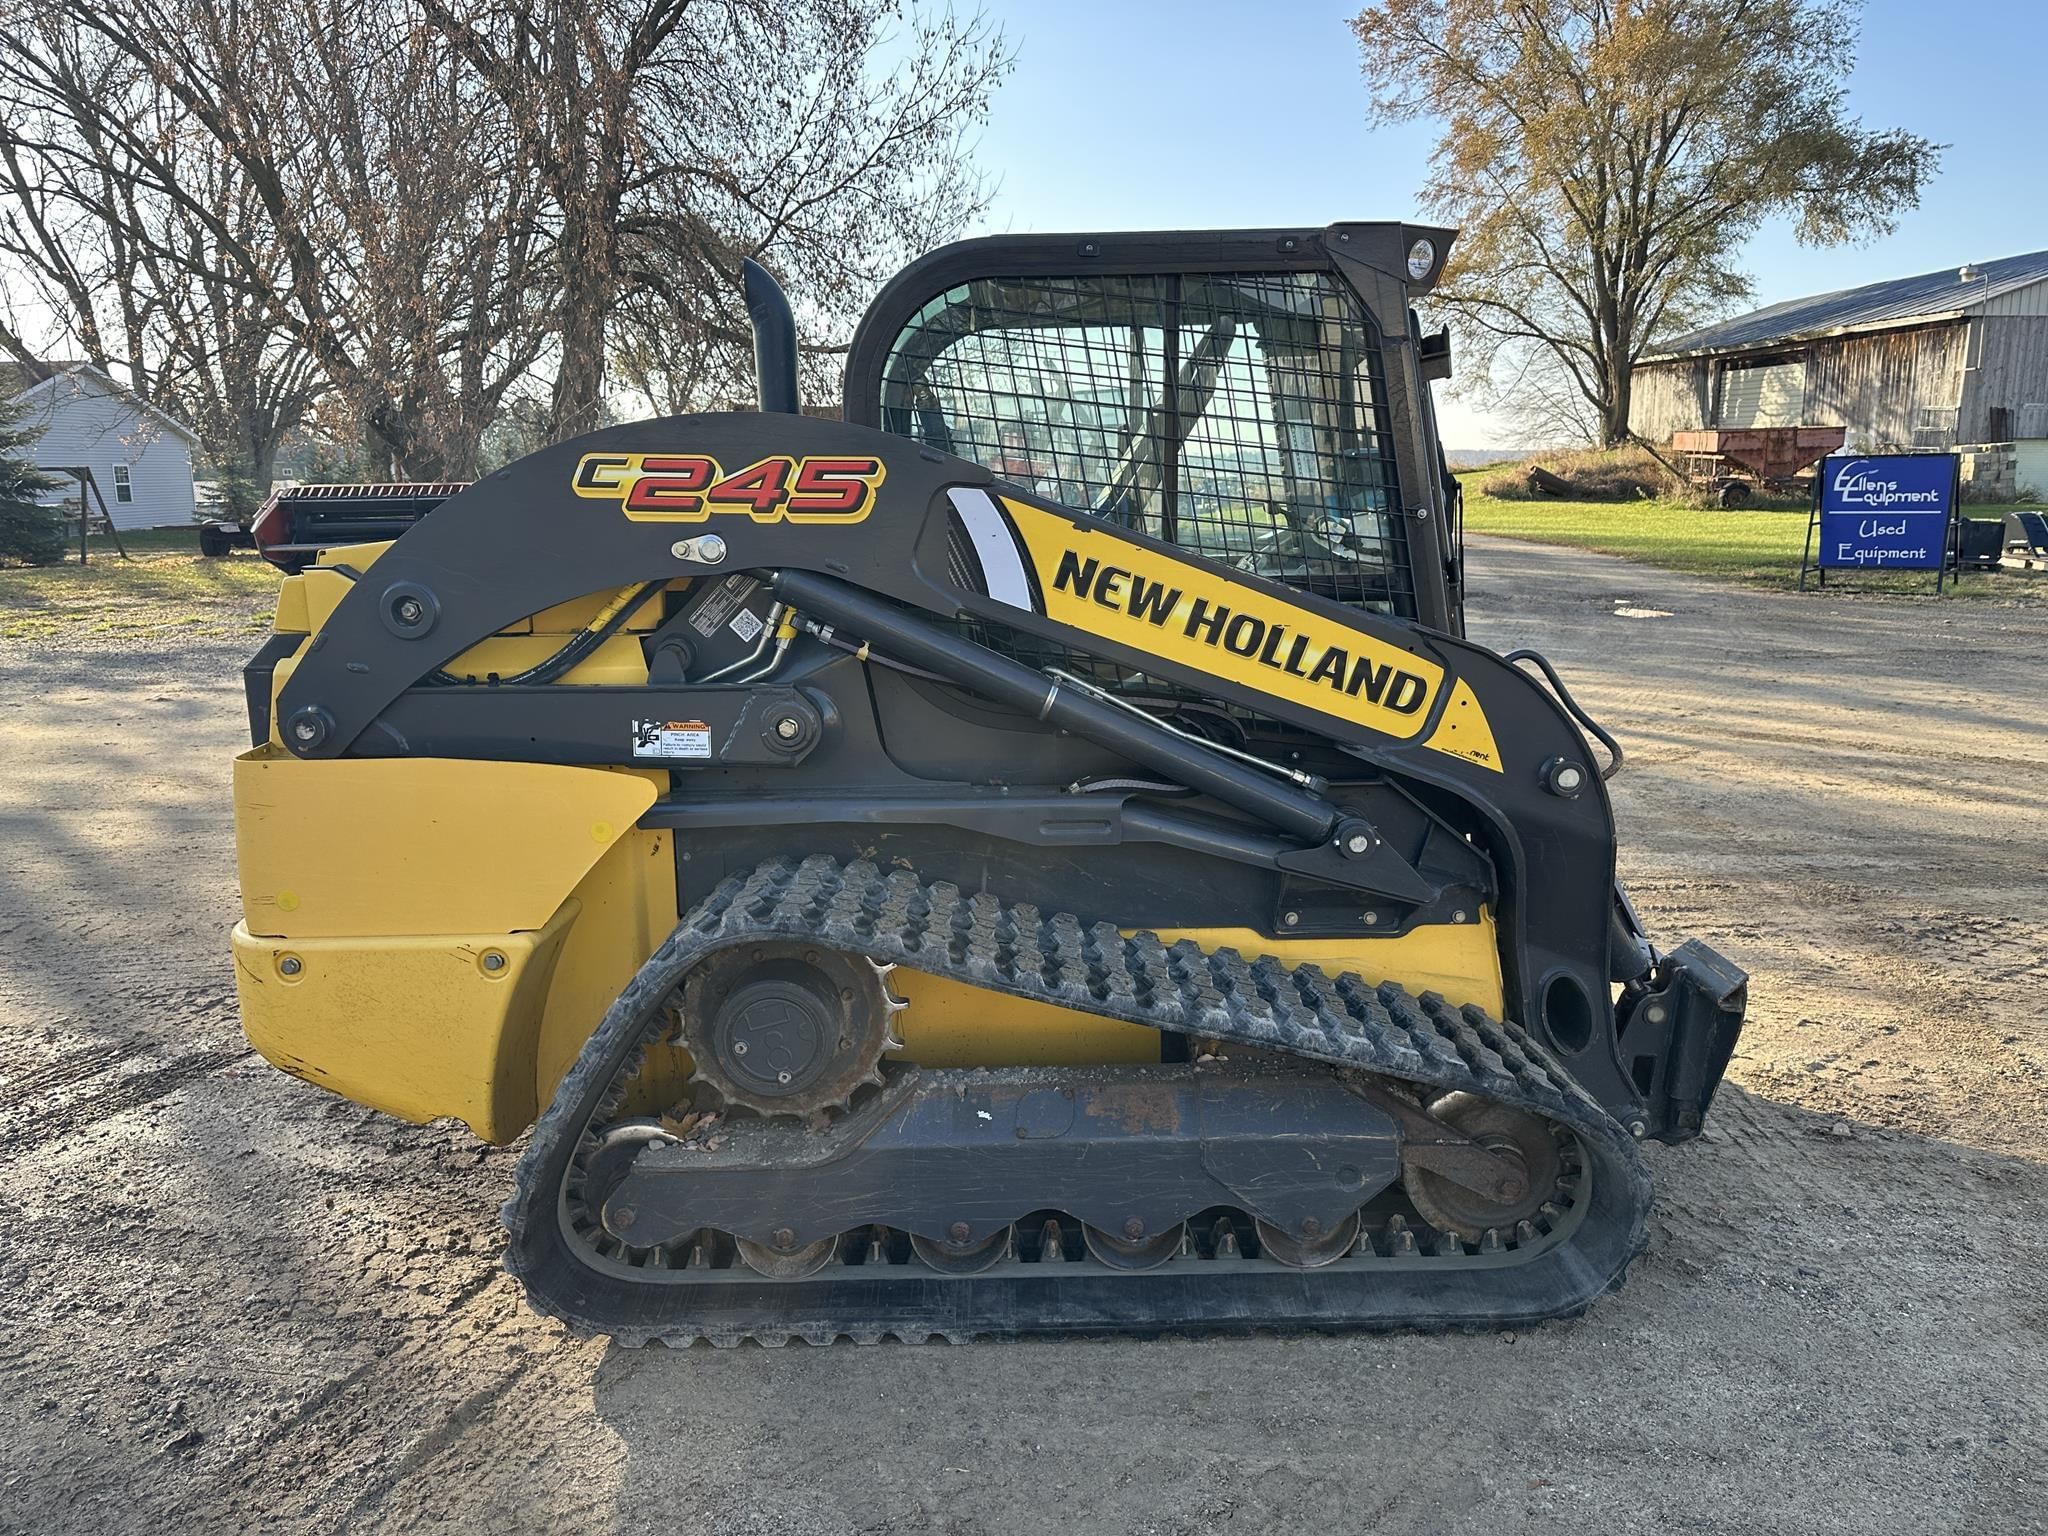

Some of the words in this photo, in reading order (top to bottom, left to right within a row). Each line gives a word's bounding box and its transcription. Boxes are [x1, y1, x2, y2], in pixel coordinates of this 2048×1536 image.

[574, 455, 883, 518] C245
[1833, 460, 1898, 492] Ellens
[1842, 470, 1940, 506] Equipment
[1858, 519, 1907, 538] Used
[1837, 543, 1927, 565] Equipment
[1051, 548, 1183, 629] NEW
[1182, 596, 1429, 716] HOLLAND
